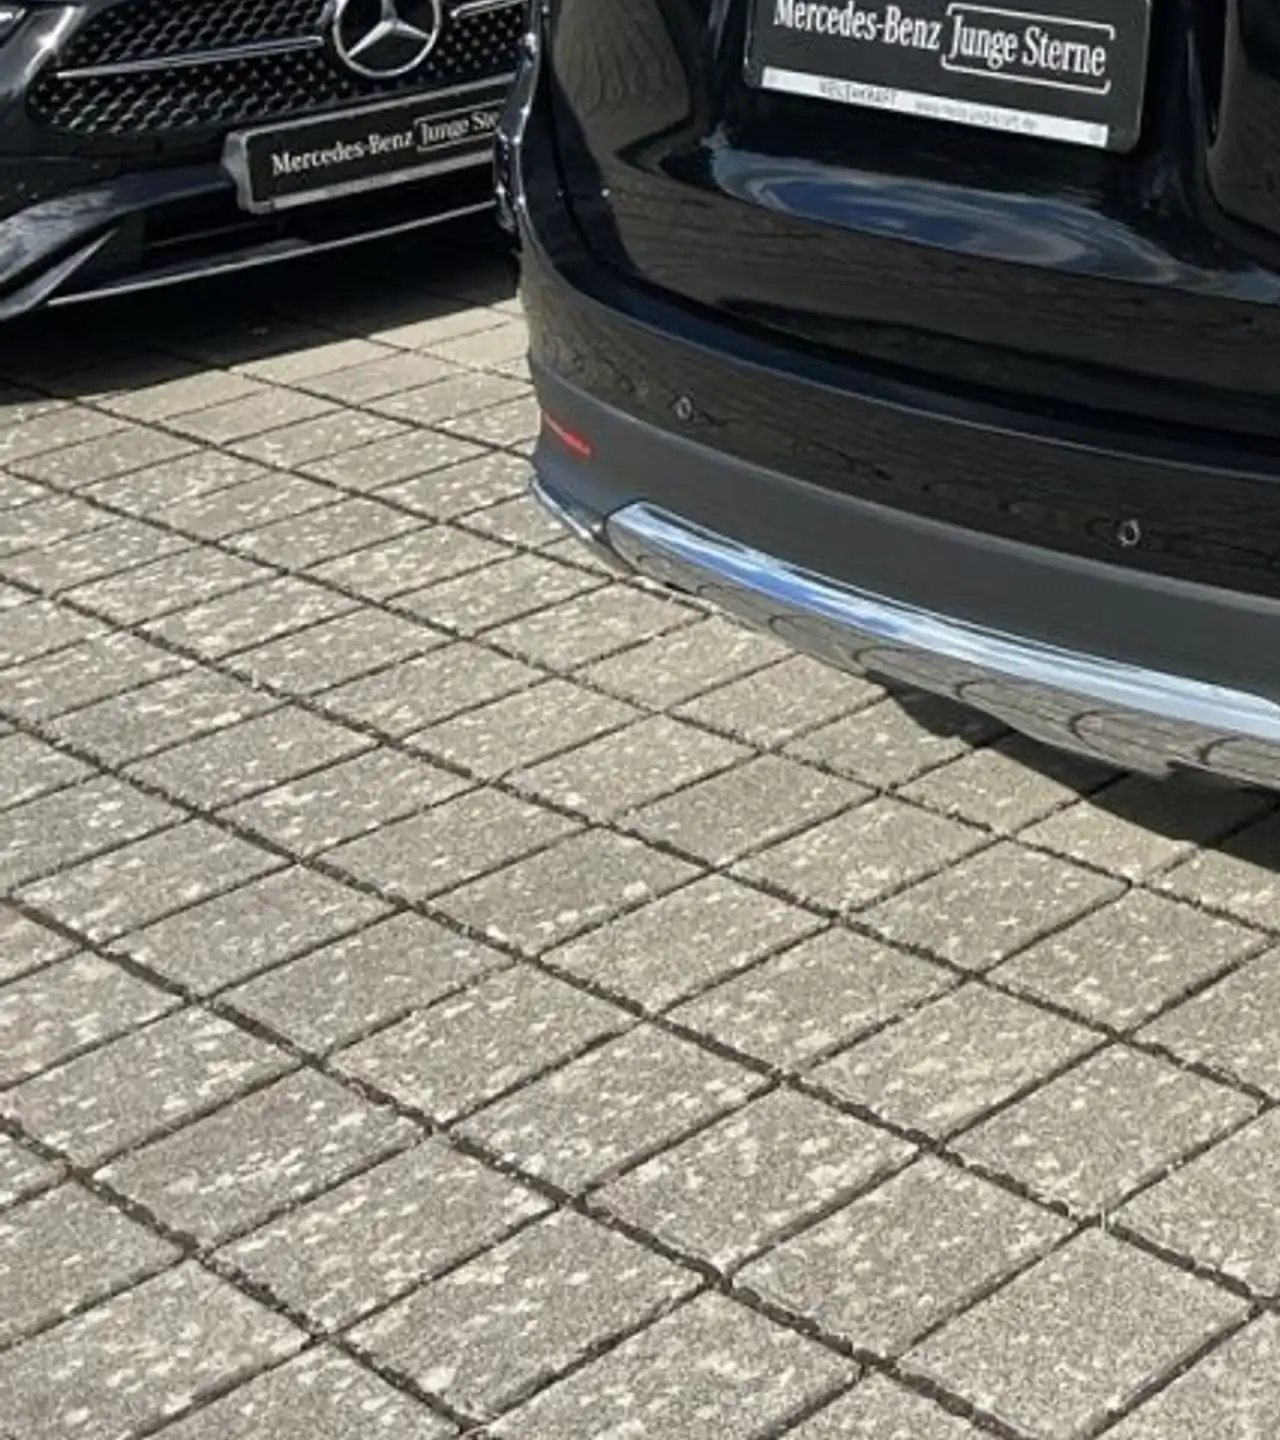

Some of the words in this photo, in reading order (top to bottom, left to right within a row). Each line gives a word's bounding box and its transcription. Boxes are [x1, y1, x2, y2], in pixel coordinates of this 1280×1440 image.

[948, 14, 1019, 70] Junge
[1021, 28, 1107, 77] Sterne
[271, 130, 414, 176] Mercedes-Benz
[420, 118, 470, 146] Junge
